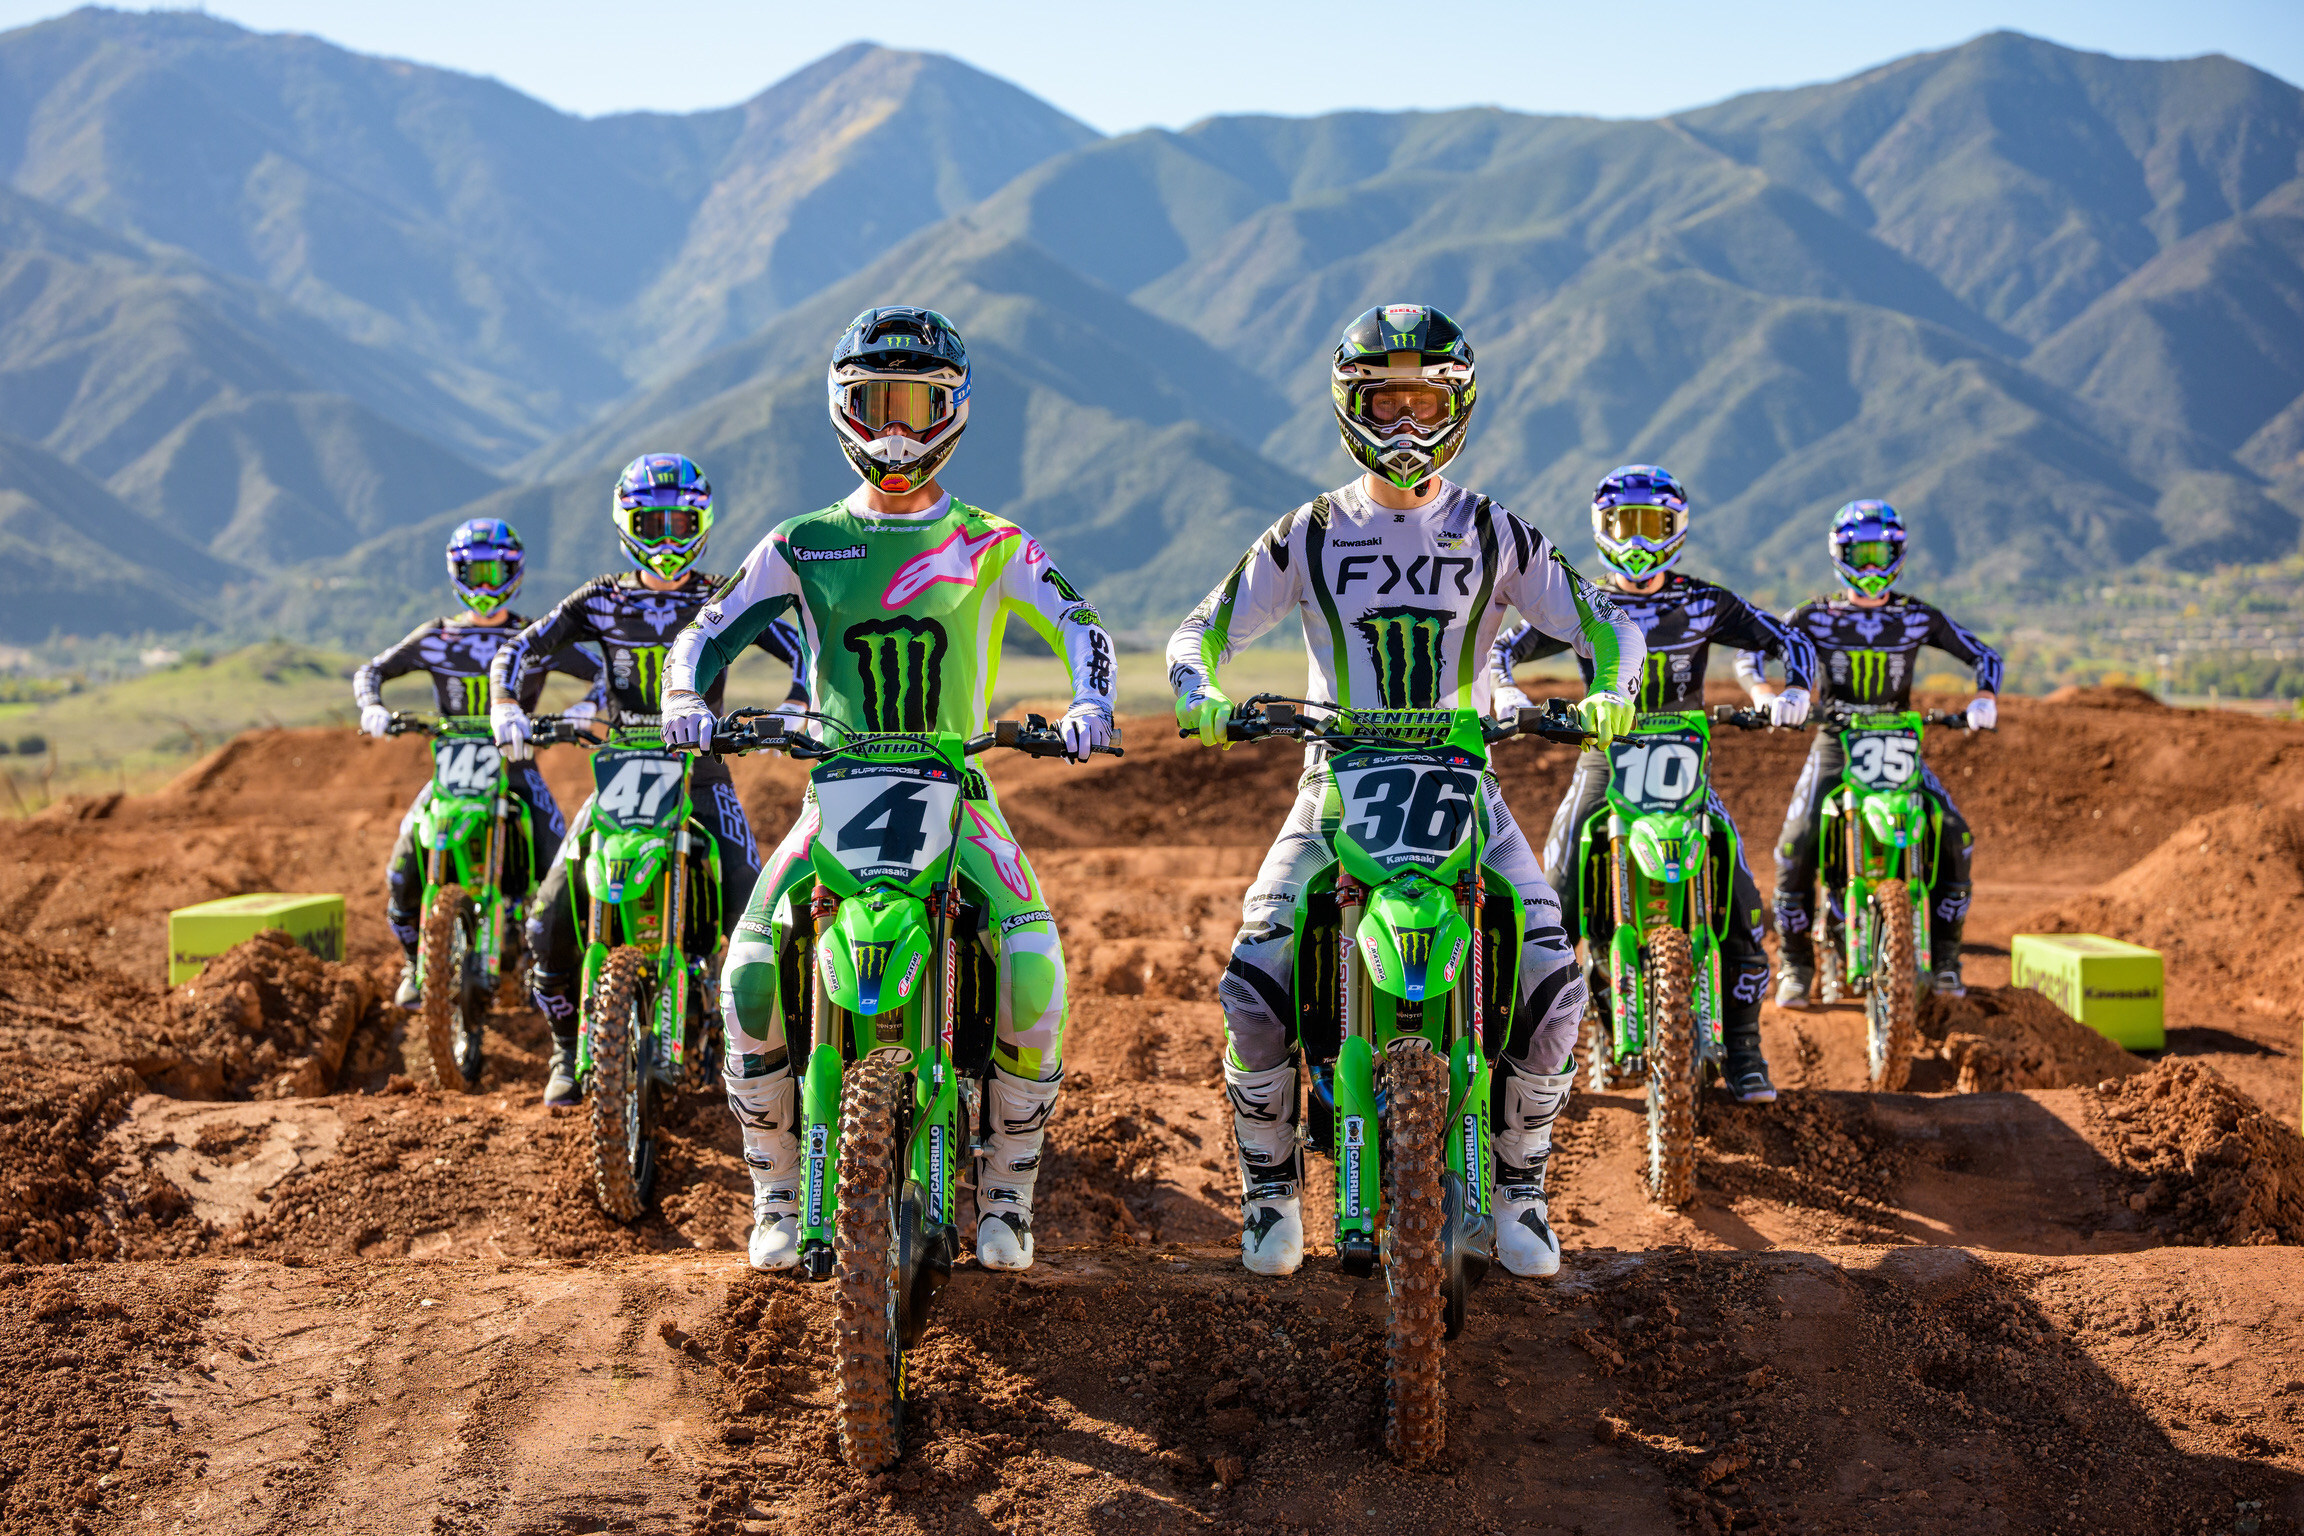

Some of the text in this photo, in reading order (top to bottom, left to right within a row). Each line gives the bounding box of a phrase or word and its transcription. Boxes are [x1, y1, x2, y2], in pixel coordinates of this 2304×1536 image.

[1332, 537, 1382, 548] Kawasaki
[1394, 514, 1405, 523] 36
[793, 545, 866, 561] Kawasaki
[1336, 554, 1474, 596] FXR
[436, 743, 502, 790] 142
[1616, 743, 1699, 804] 10
[1850, 736, 1919, 784] 35
[598, 758, 684, 819] 47
[1347, 768, 1478, 853] 36
[836, 780, 931, 864] 4
[860, 868, 909, 878] Kawasaki
[1386, 855, 1436, 865] Kawasaki
[1625, 963, 1638, 1044] DUNLOP
[2085, 985, 2158, 998] Kawasaki
[931, 1125, 940, 1192] CARRILLO
[1464, 1115, 1476, 1182] CARRILLO
[811, 1159, 823, 1226] CARRILLO
[1350, 1150, 1360, 1217] CARRILLO
